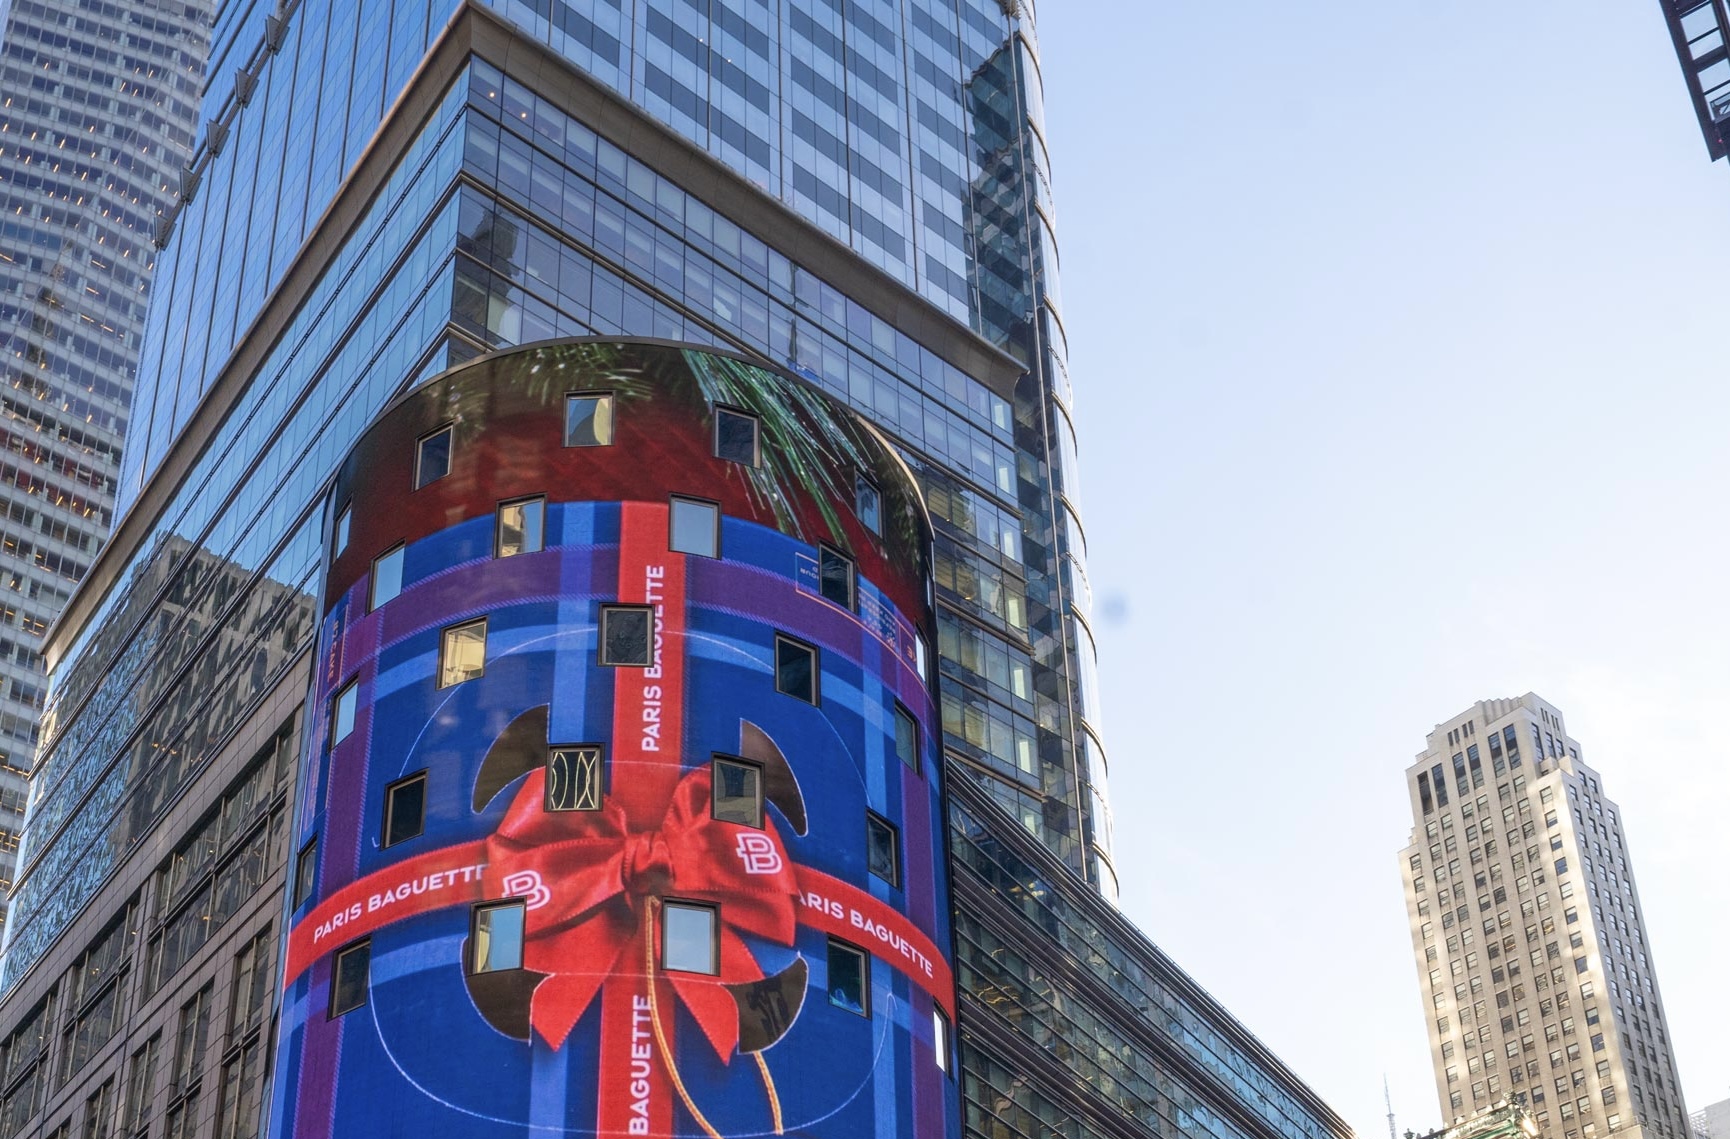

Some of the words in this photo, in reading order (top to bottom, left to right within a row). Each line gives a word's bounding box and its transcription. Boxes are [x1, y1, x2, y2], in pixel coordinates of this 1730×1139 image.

[641, 685, 662, 751] PARIS
[313, 902, 362, 944] PARIS
[799, 891, 844, 919] RIS
[850, 909, 934, 979] BAGUETTE
[628, 994, 652, 1135] BAGUETTE
